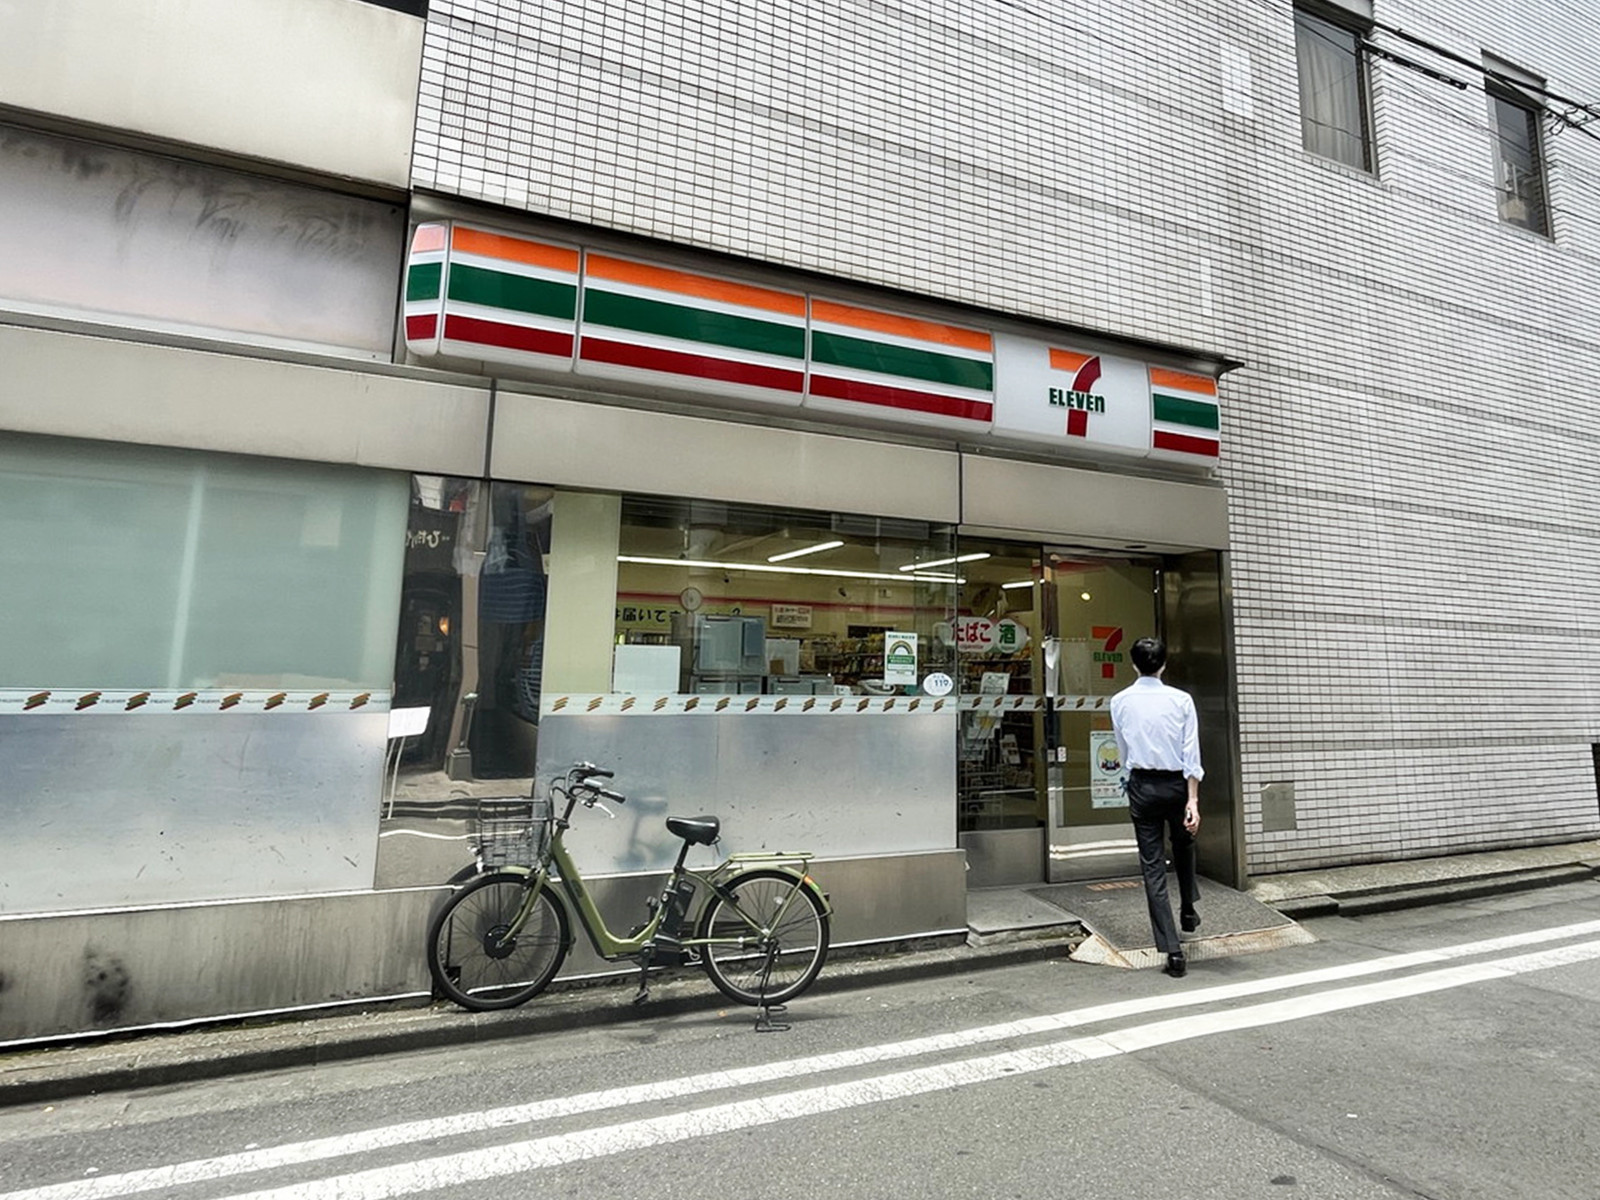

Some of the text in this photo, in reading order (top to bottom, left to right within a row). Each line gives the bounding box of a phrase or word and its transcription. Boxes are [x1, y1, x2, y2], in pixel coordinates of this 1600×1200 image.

[1049, 347, 1102, 437] 7
[951, 621, 1016, 644] たばこ 酒
[1092, 626, 1123, 679] 7
